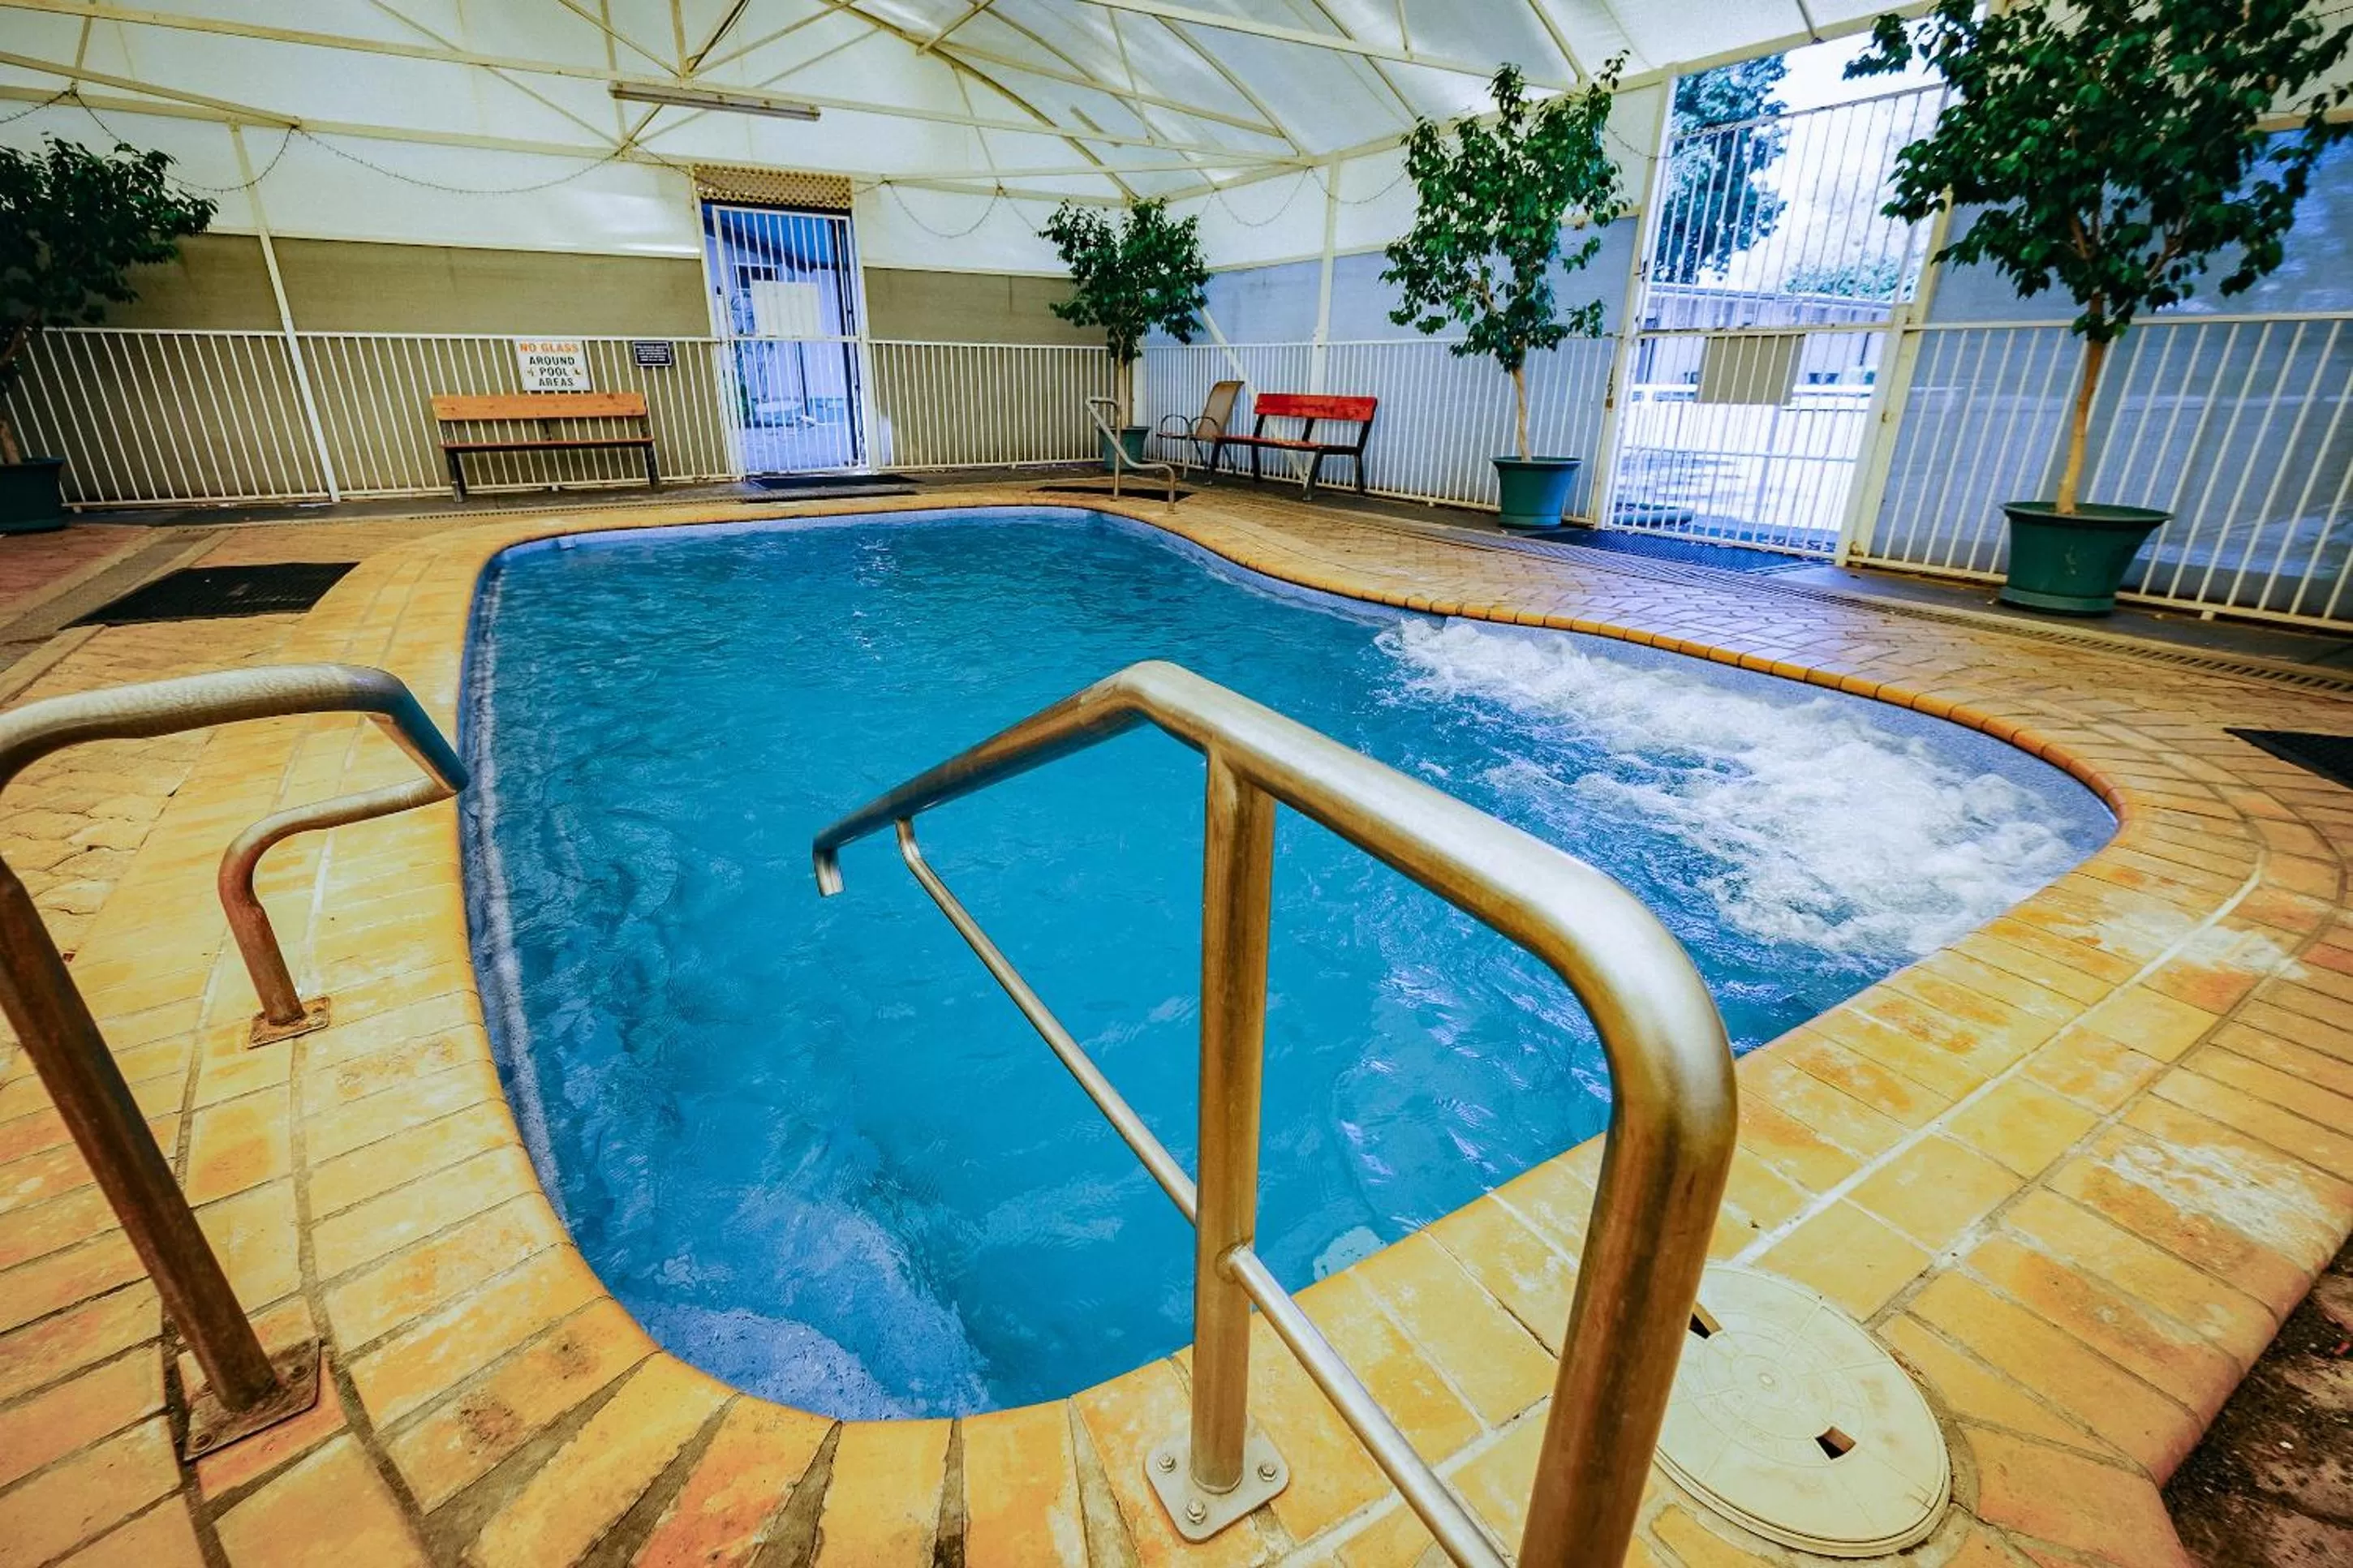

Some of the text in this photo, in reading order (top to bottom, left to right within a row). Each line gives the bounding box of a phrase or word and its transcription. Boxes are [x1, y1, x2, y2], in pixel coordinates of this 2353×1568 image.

[520, 343, 578, 353] NO GLASS
[530, 356, 574, 366] AROUND
[539, 367, 569, 376] POOL
[539, 378, 574, 386] AREAS
